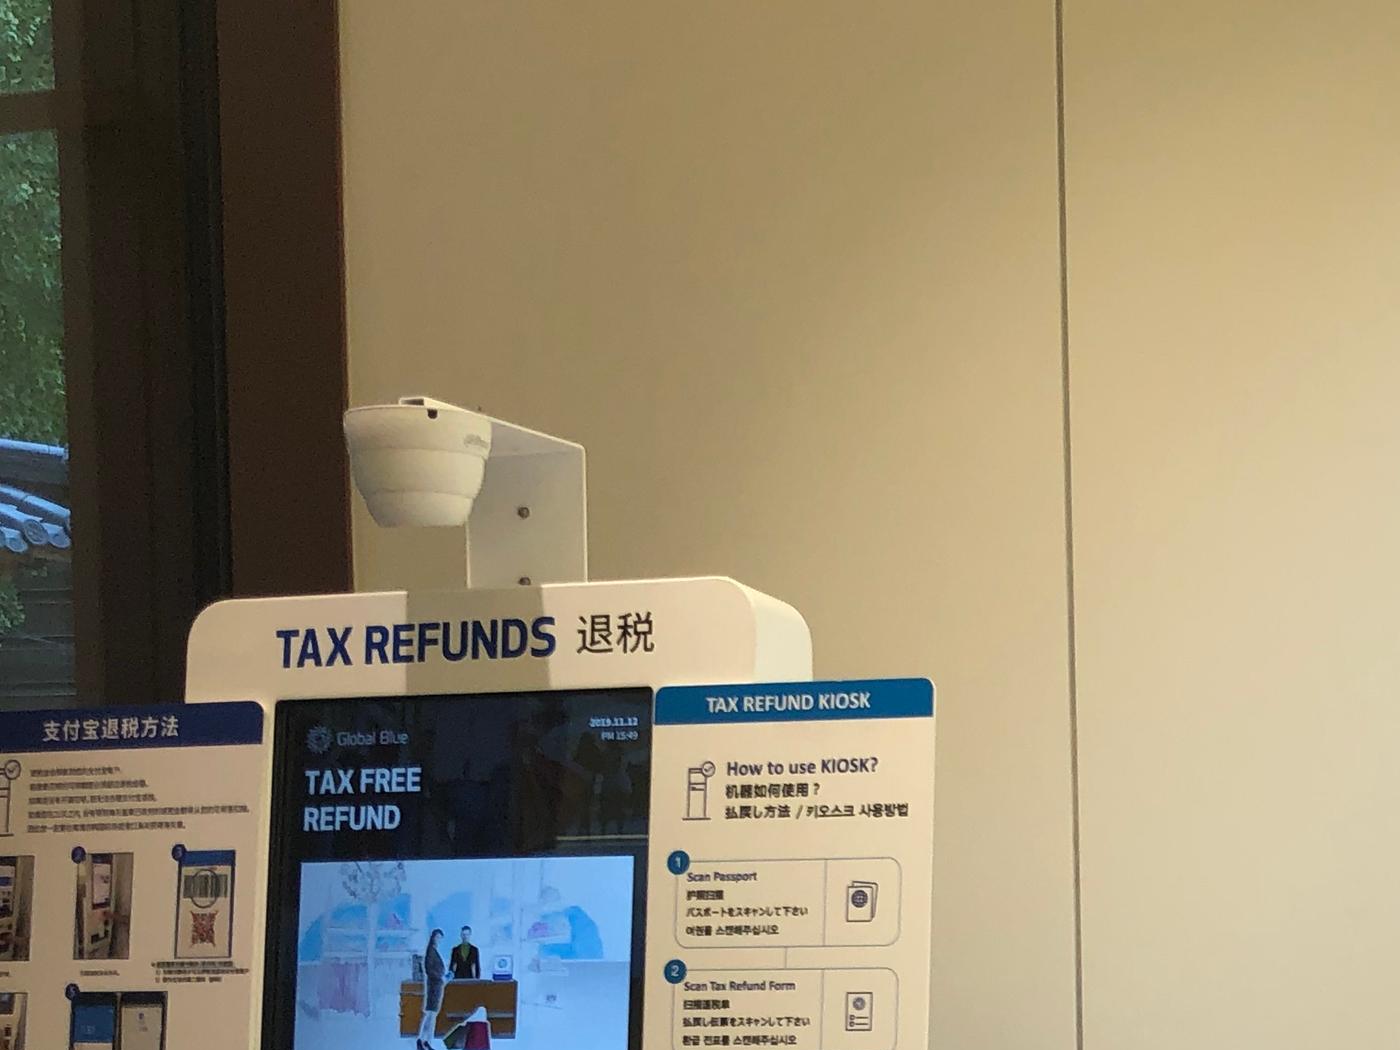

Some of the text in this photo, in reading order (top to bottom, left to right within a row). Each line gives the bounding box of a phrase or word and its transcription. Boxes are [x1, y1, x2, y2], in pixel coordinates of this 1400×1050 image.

[276, 611, 655, 669] TAX REFUNDS 退税
[706, 691, 871, 714] TAX REFUND KIOSK
[42, 715, 180, 742] 支付宝退税方法
[336, 729, 409, 746] Global Blue
[726, 756, 879, 776] How to use KIOSK?
[304, 766, 422, 795] TAX FREE
[303, 805, 400, 832] REFUND
[686, 870, 758, 883] Scan Passport
[684, 981, 796, 992] Scan Tax Refund Form
